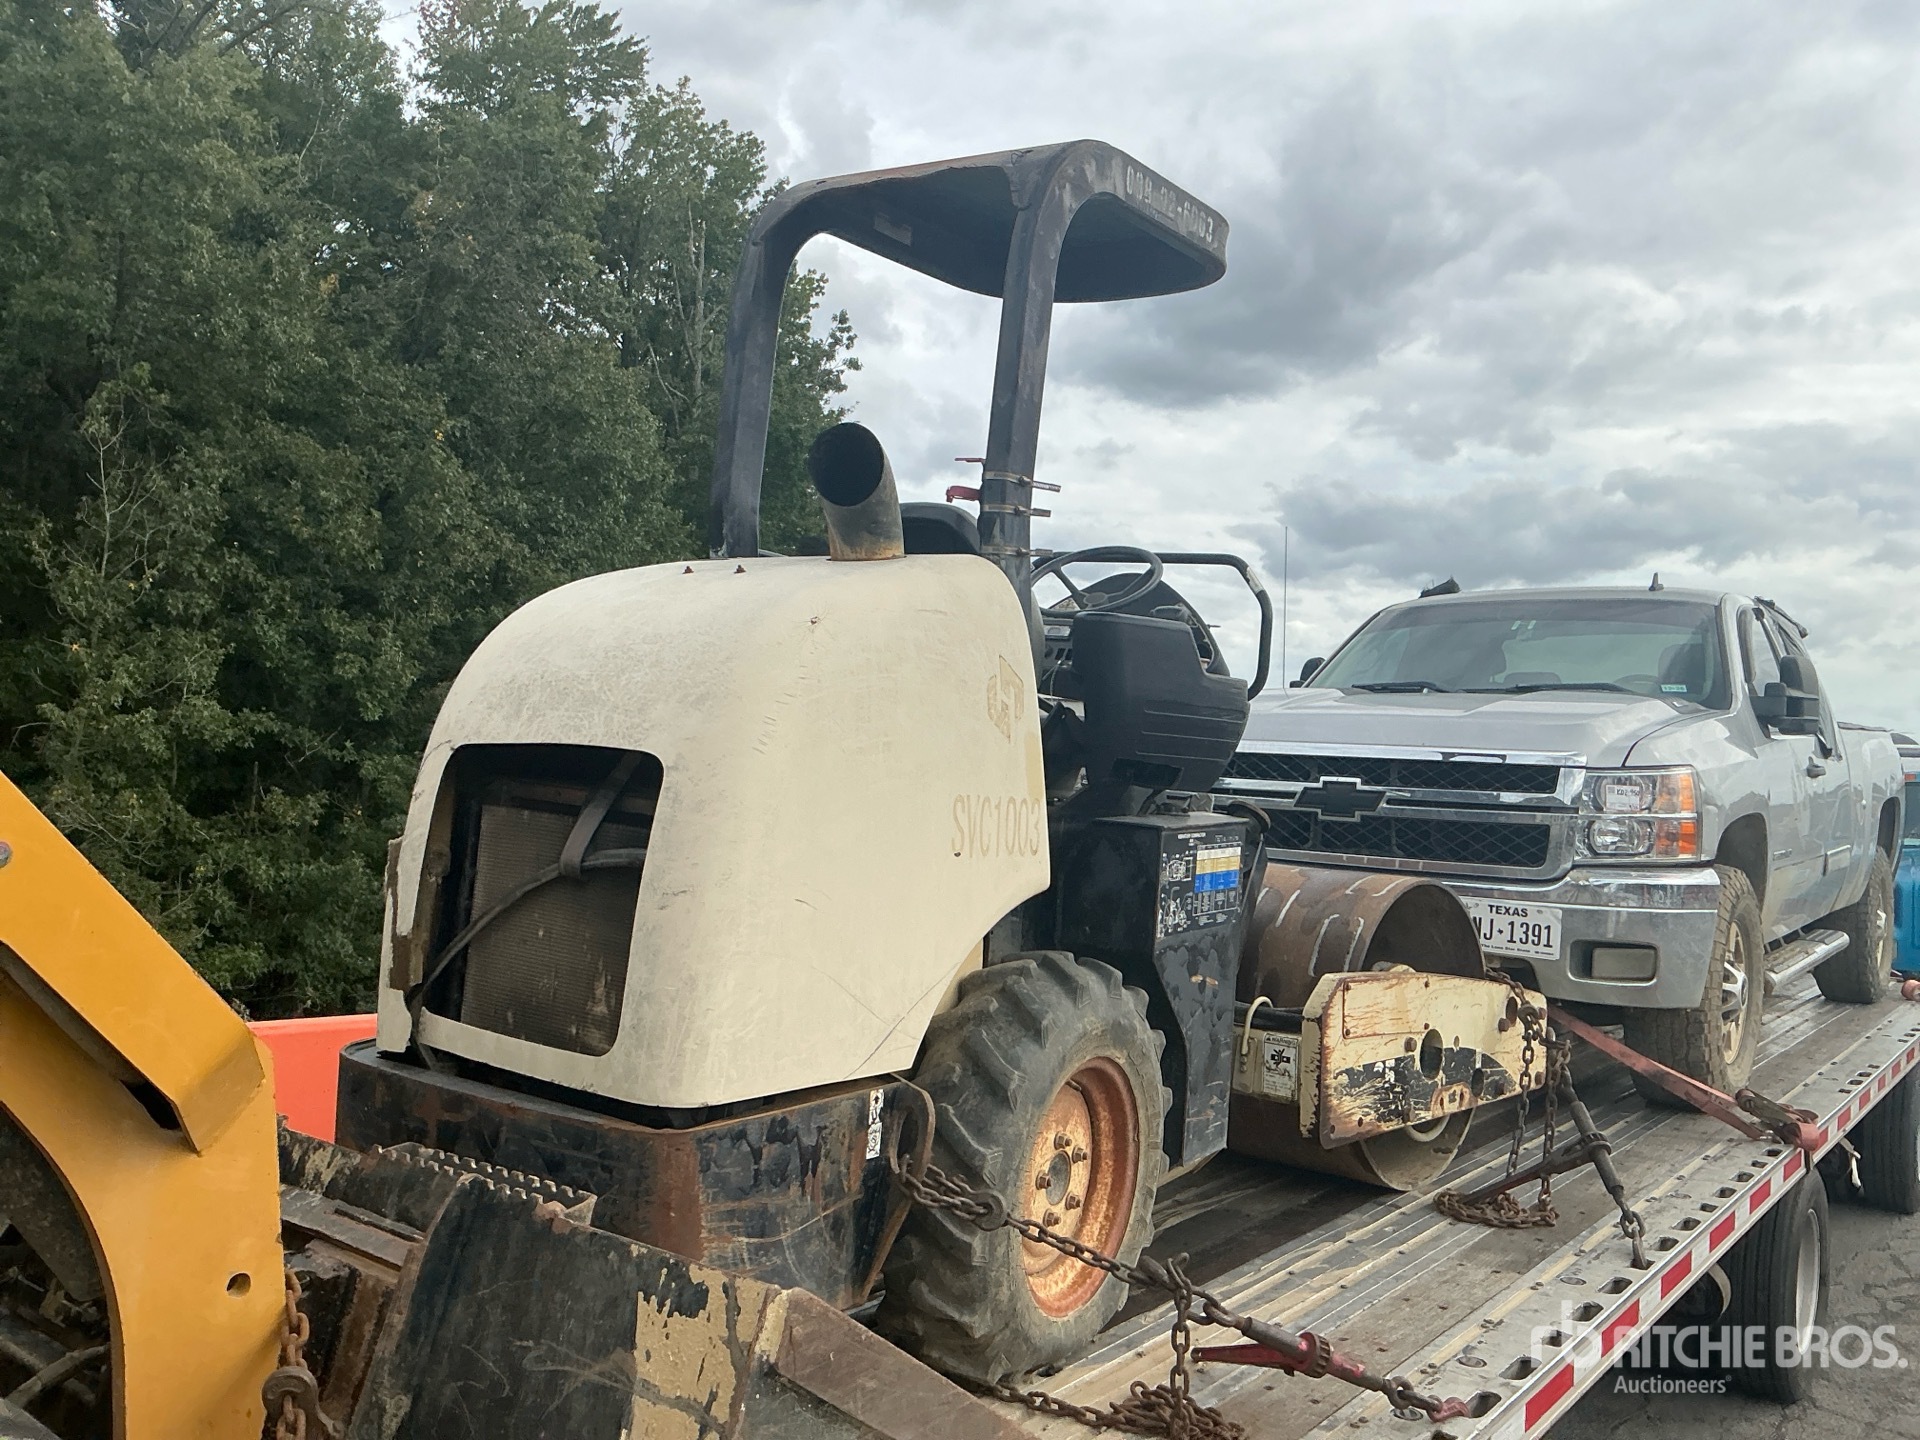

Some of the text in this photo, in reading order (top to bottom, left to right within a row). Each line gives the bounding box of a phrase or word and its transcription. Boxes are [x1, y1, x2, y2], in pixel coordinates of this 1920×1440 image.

[952, 794, 1041, 858] SVC1003
[1488, 904, 1528, 917] TEXAS
[1507, 920, 1553, 949] 1391
